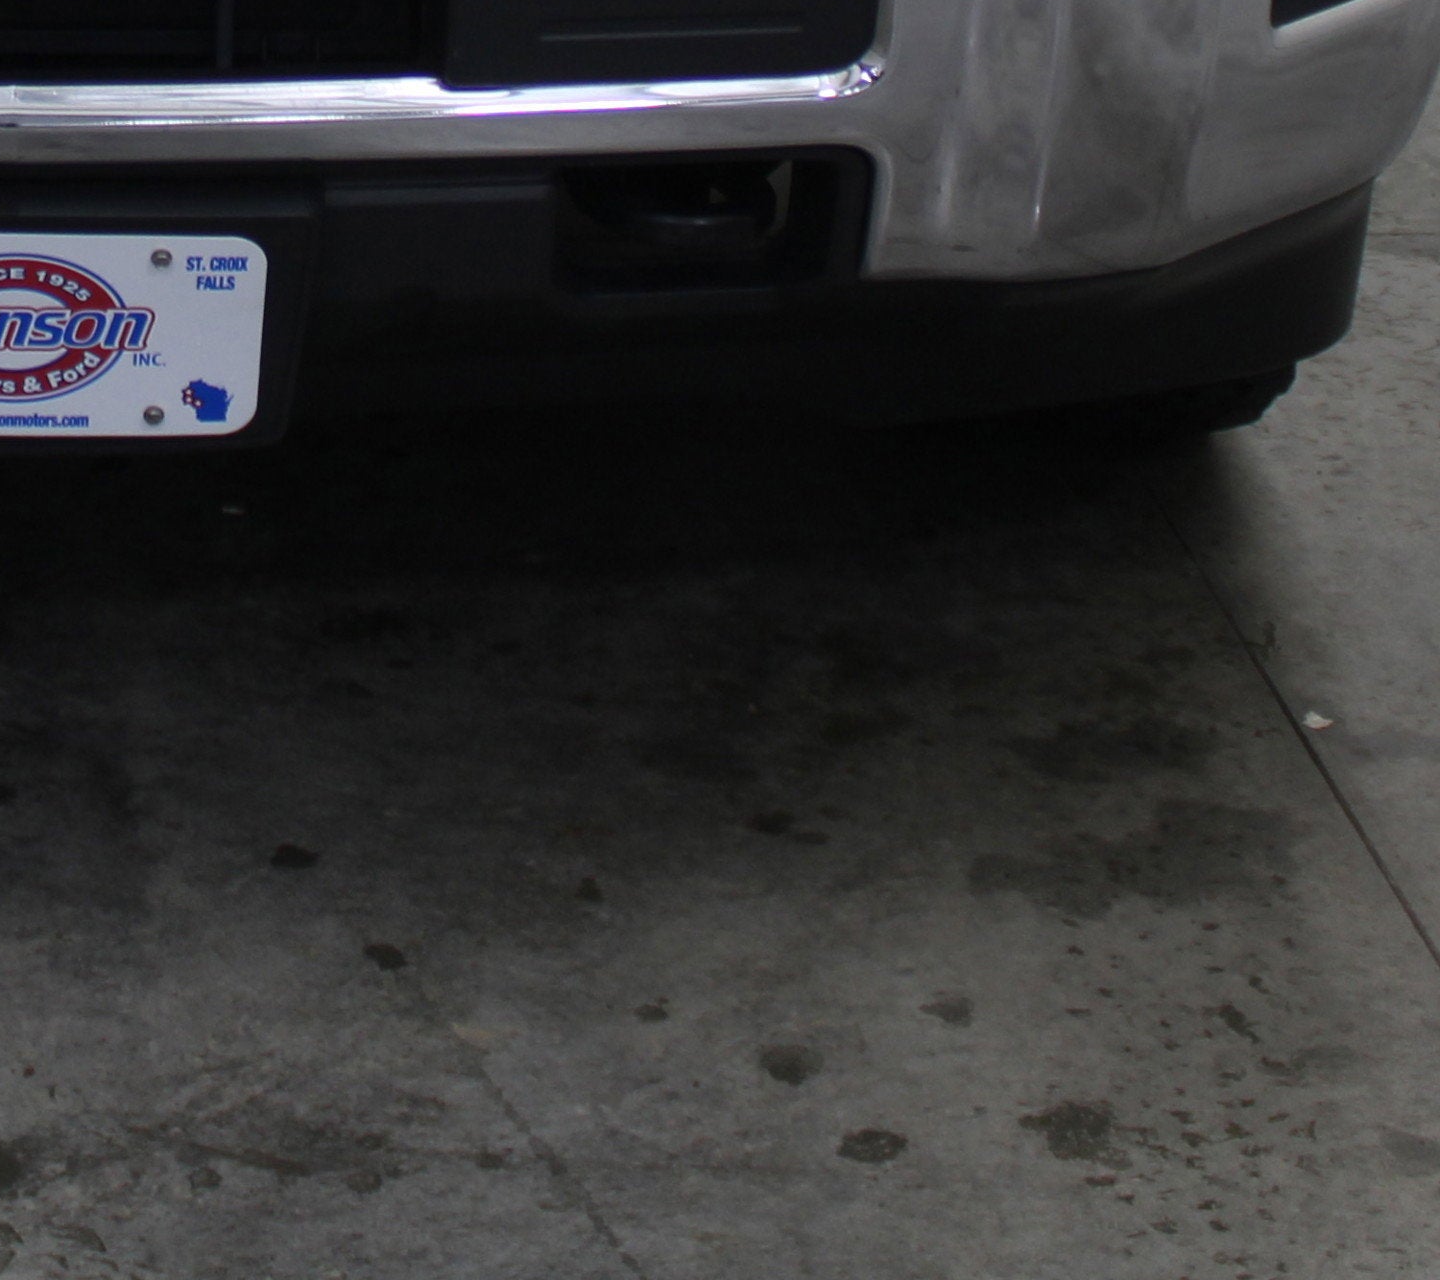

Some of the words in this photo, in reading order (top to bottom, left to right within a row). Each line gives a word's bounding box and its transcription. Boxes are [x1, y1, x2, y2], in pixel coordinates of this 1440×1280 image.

[185, 256, 206, 271] ST.
[210, 256, 249, 271] CROIX
[36, 270, 91, 301] 1925
[196, 275, 236, 290] FALLS
[132, 353, 166, 367] INC.
[22, 376, 44, 394] &
[46, 351, 102, 389] Ford
